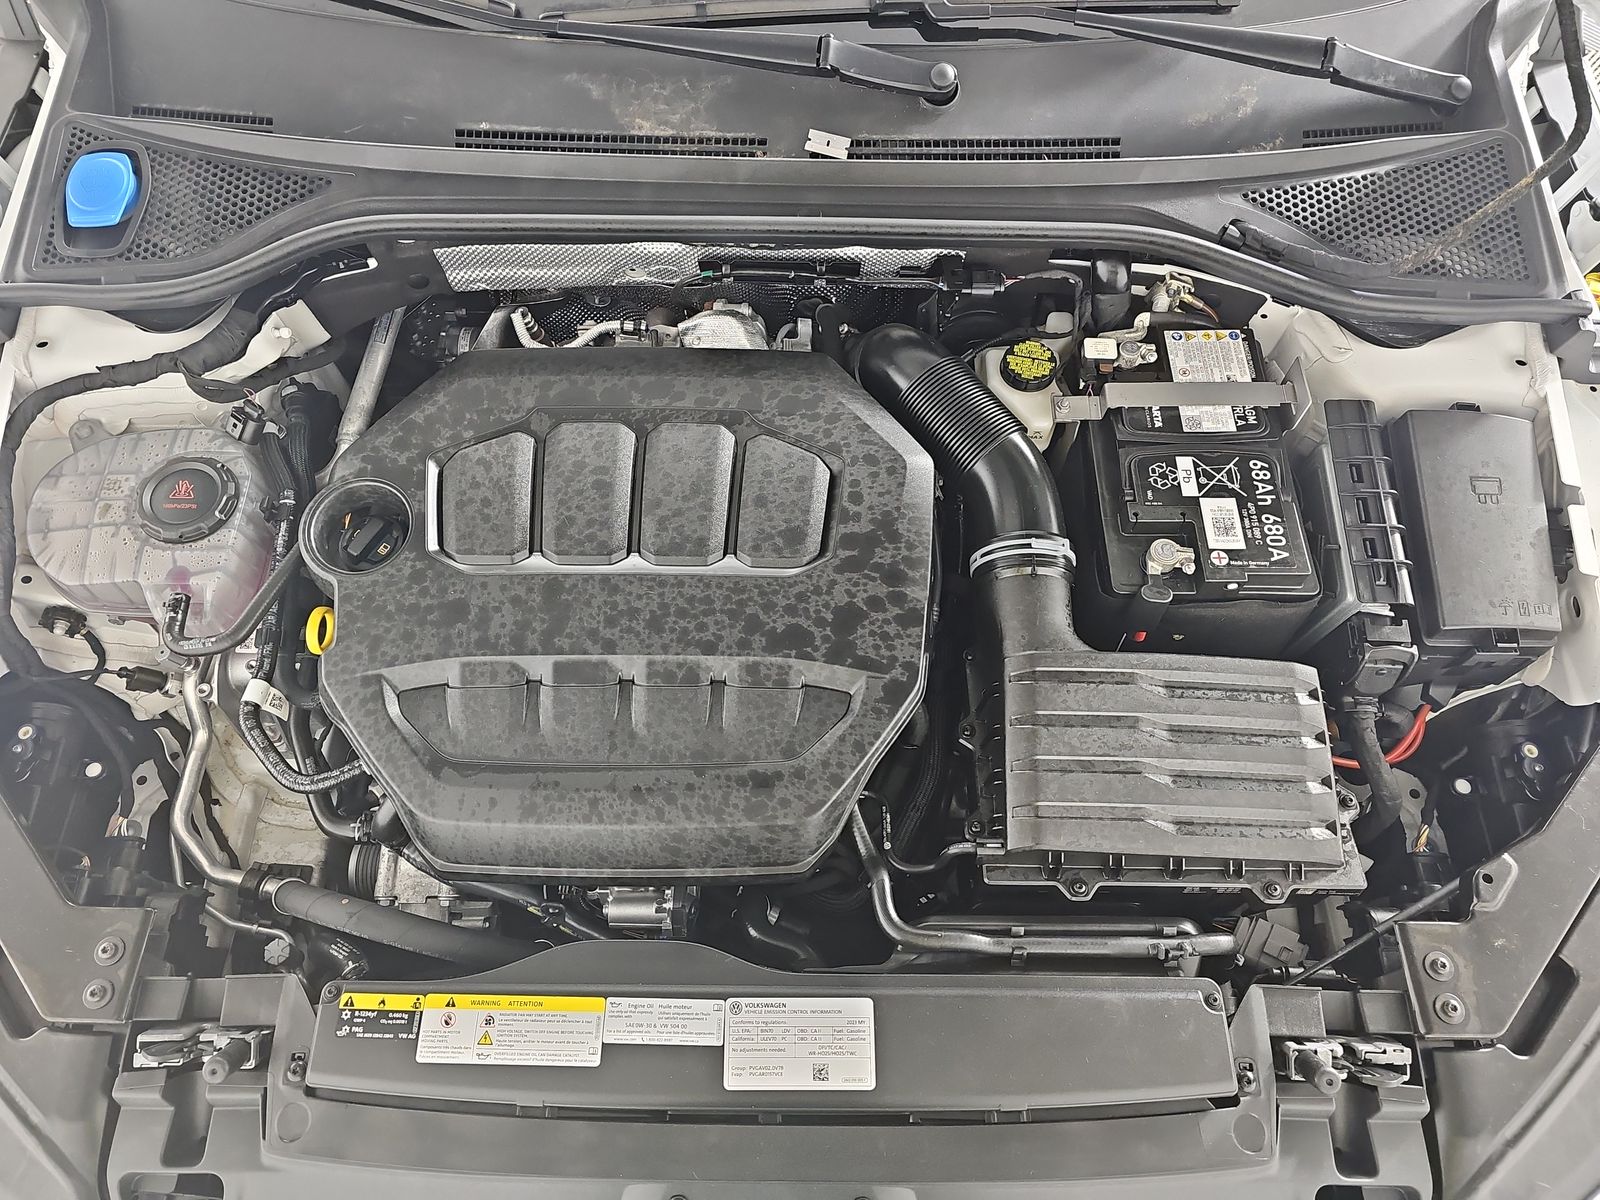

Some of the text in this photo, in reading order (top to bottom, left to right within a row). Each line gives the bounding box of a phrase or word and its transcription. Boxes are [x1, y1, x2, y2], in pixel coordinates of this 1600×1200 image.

[1152, 406, 1162, 428] ARTA
[1232, 405, 1246, 426] RLA
[1181, 469, 1192, 484] Pb
[1249, 459, 1290, 561] 68Ah 680A
